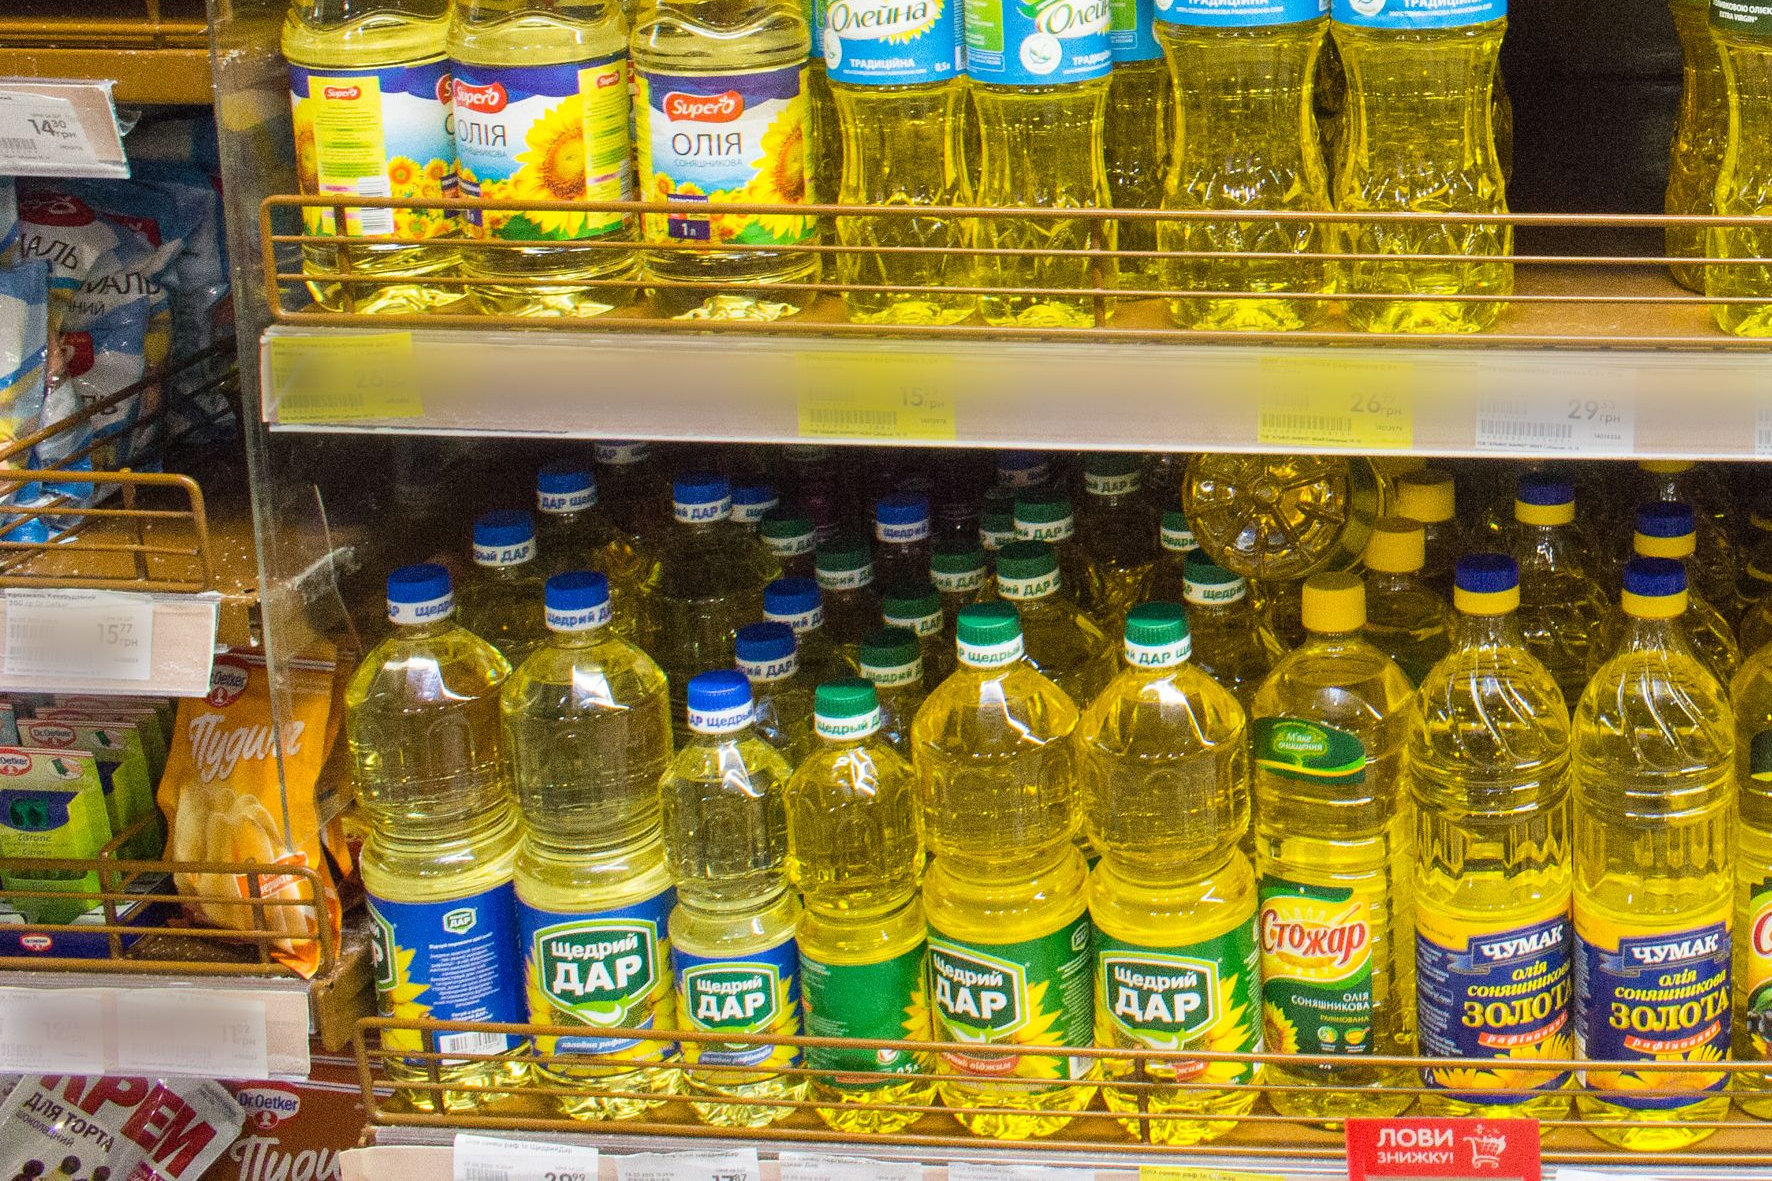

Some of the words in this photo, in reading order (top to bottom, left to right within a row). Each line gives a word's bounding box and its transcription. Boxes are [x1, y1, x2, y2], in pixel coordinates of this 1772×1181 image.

[832, 1, 928, 32] Олейна
[671, 95, 737, 118] Supero
[458, 119, 507, 147] ОЛІЯ
[671, 132, 743, 156] ОЛІЯ
[552, 931, 638, 959] Щедрий
[1261, 907, 1366, 968] Стожар
[1480, 925, 1564, 962] ЧУМАК
[1631, 932, 1719, 965] ЧУМАК
[552, 955, 643, 997] ДАР
[697, 975, 762, 995] Щедрий
[1114, 965, 1197, 990] Щедрий
[1614, 967, 1727, 1001] соняшникова
[1659, 968, 1697, 988] олія
[697, 992, 767, 1021] ДАР
[1116, 987, 1201, 1024] ДАР
[1291, 997, 1370, 1011] СОНЯШНИКОВА
[1344, 991, 1369, 1002] ОЛІЯ
[1609, 991, 1728, 1032] ЗОЛОТА
[25, 1091, 62, 1121] ДЛЯ
[66, 1109, 116, 1153] ТОРТА
[1377, 1126, 1454, 1148] ЛОВИ
[1377, 1151, 1454, 1164] ЗНИЖКУ!
